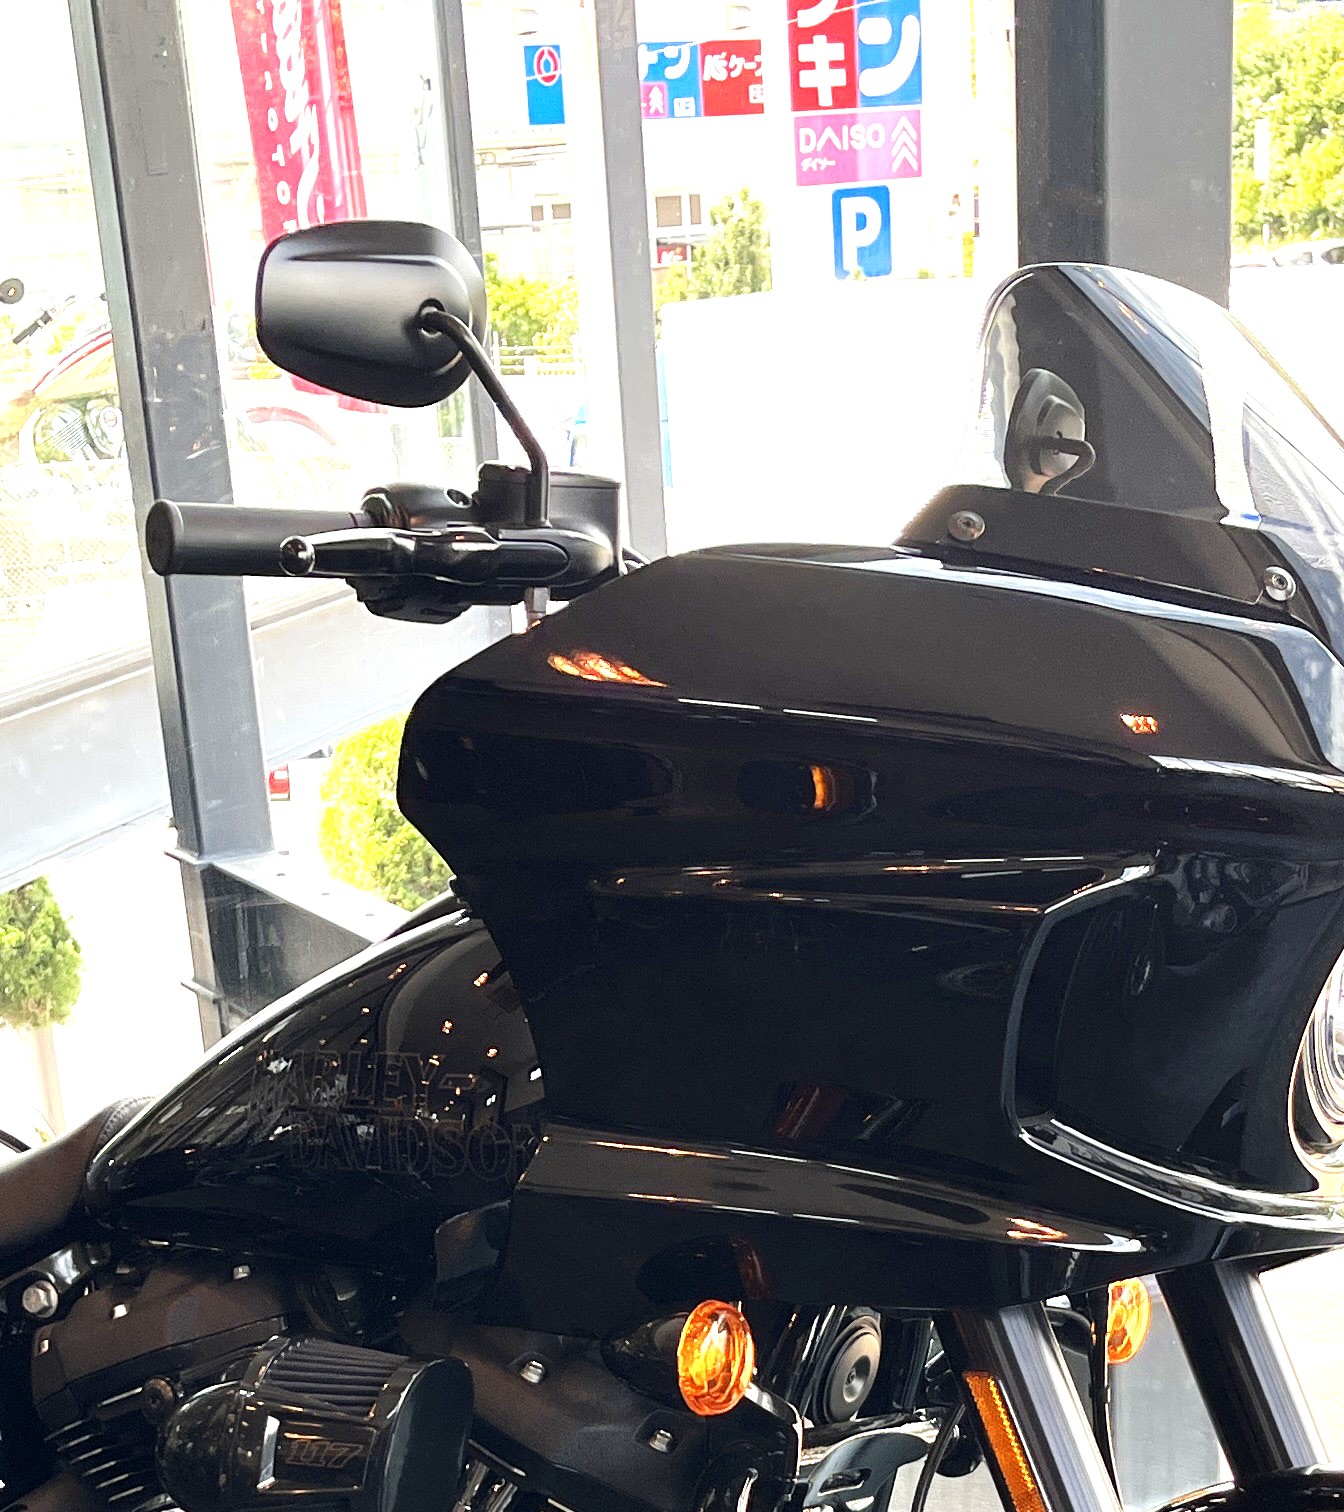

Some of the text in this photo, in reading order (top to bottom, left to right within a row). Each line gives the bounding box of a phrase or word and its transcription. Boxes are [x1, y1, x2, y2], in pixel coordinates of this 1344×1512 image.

[798, 122, 886, 154] DAISO
[840, 195, 882, 272] P
[284, 1440, 365, 1469] 117
